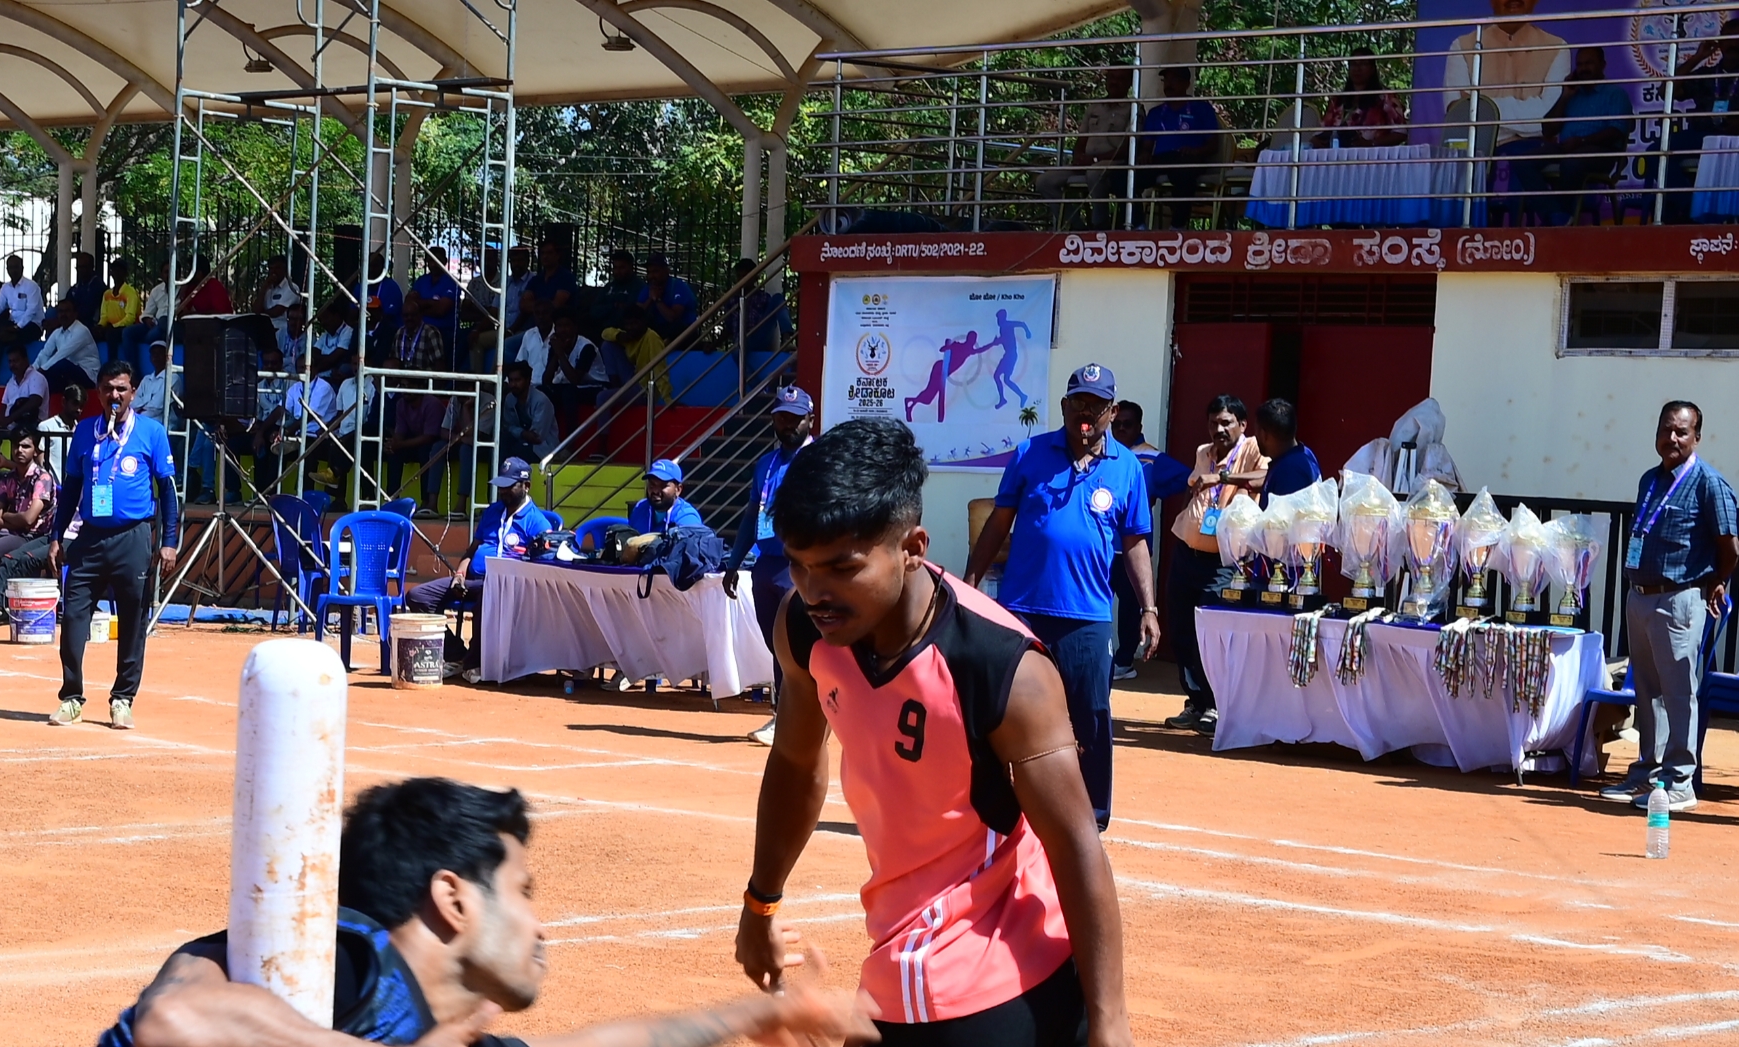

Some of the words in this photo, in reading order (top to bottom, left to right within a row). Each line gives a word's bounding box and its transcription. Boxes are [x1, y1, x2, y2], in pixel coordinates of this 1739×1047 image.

[1059, 232, 1232, 267] ವಿವೇಕಾನಂದ
[1244, 231, 1332, 270] ಕ್ರೀಡಾ
[1352, 228, 1447, 271] ಸಂಸ್ಥೆ
[858, 399, 884, 407] 2025-26
[894, 698, 927, 763] 9
